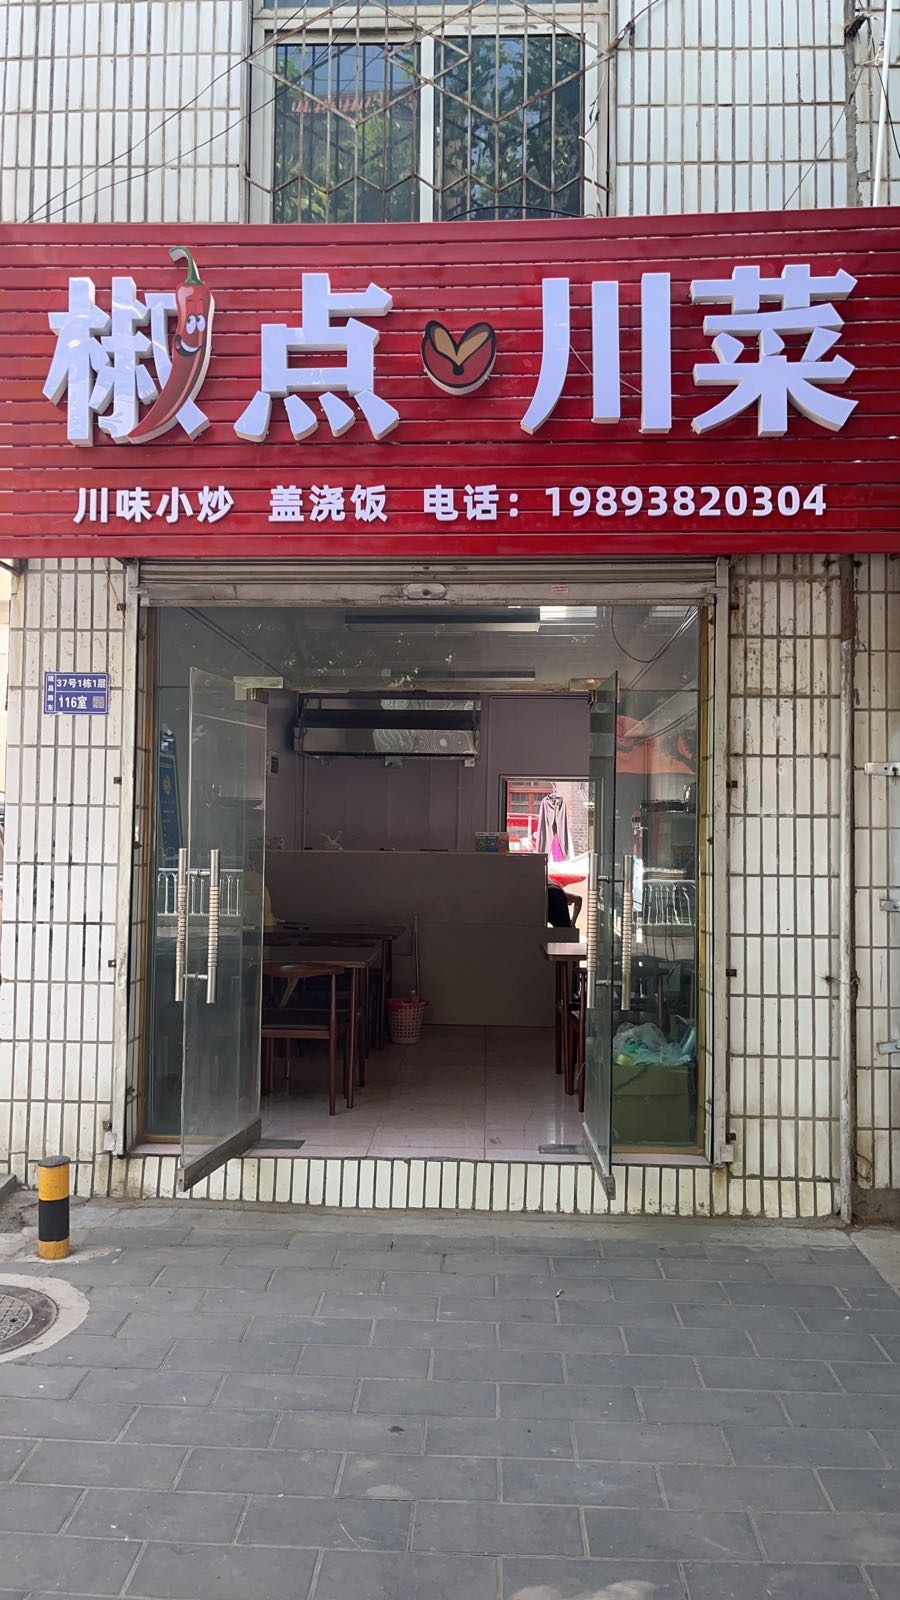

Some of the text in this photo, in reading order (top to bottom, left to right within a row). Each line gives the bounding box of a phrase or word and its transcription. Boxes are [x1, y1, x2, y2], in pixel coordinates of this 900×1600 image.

[520, 262, 859, 436] 川菜
[73, 486, 235, 524] 川味小炒
[269, 485, 389, 523] 盖浇饭
[56, 678, 106, 689] 37号1栋1层
[58, 695, 88, 709] 116室
